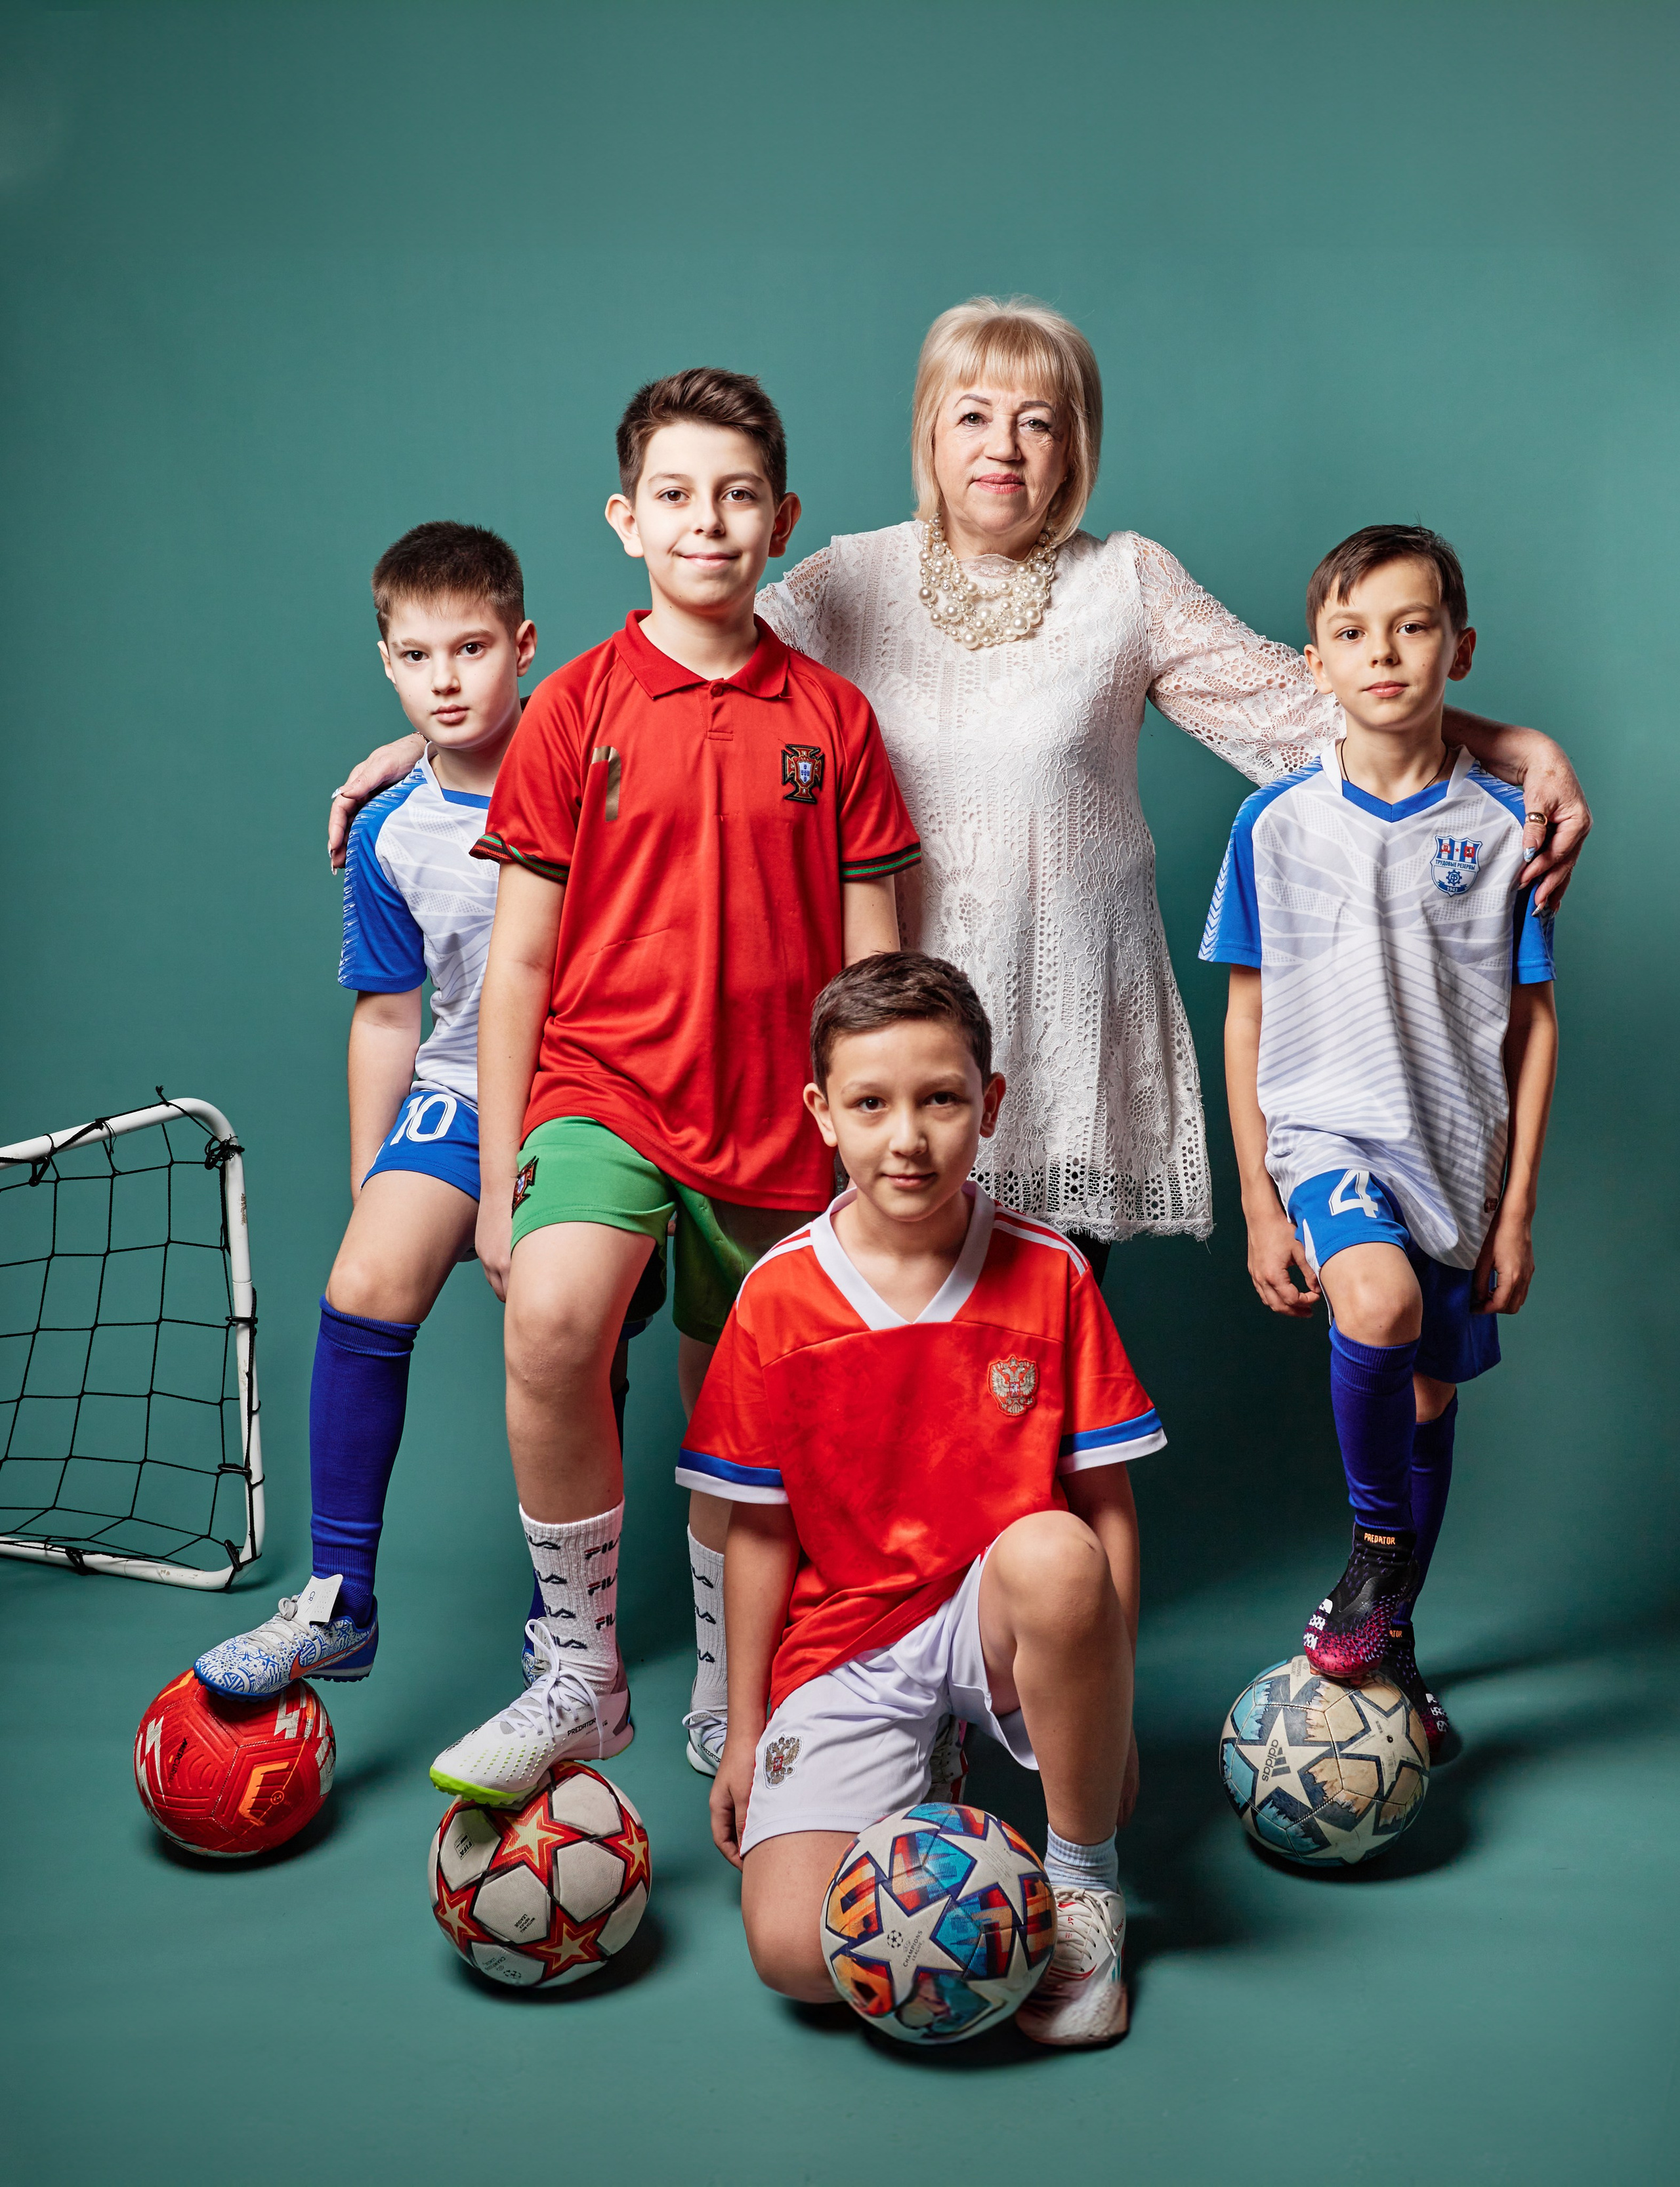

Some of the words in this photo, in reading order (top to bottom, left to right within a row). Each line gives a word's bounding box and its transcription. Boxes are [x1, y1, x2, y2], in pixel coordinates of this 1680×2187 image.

[390, 1094, 457, 1145] 10
[1328, 1169, 1378, 1218] 4
[1364, 1532, 1396, 1545] PREDATOR
[595, 1613, 616, 1630] FIL
[567, 1717, 597, 1736] PREDATOR
[167, 1738, 188, 1783] MERCURIAL
[1262, 1739, 1278, 1781] adidas
[459, 1841, 472, 1856] FIFA
[514, 1913, 528, 1928] LEAGUE
[903, 1930, 923, 1967] CHAMPIONS
[912, 1942, 923, 1961] LEAGUE
